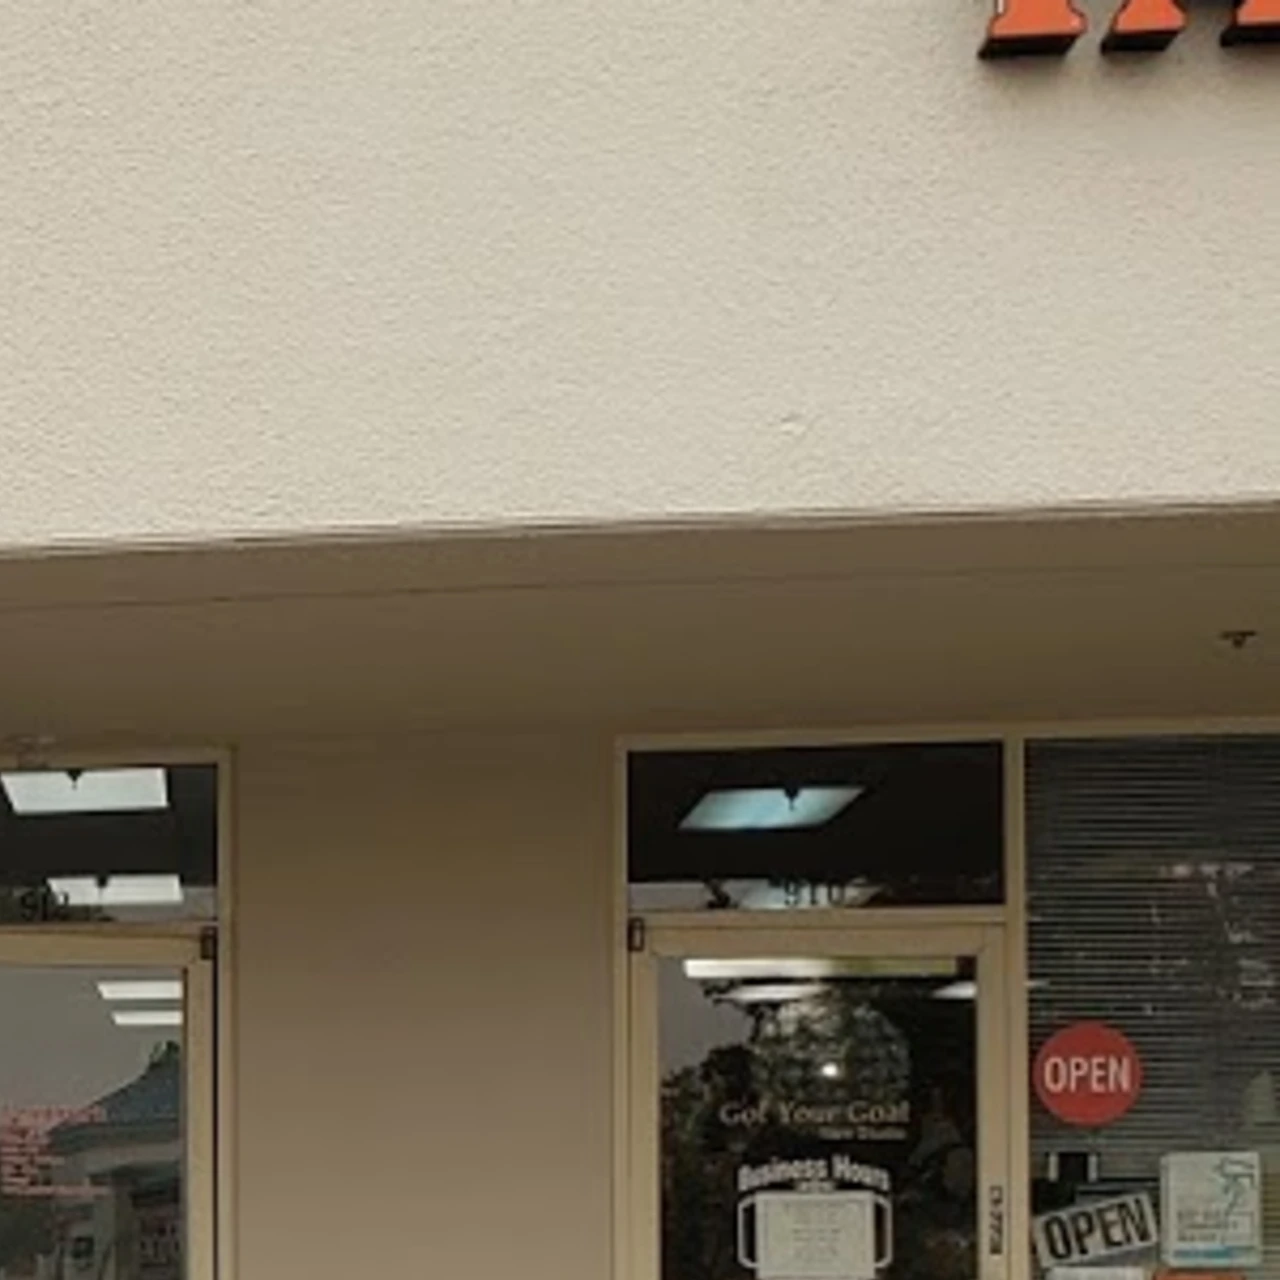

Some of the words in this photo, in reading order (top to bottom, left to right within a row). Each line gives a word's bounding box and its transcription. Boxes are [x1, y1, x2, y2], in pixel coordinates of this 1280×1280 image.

[1044, 1057, 1131, 1092] OPEN
[737, 1157, 829, 1191] Business
[831, 1153, 889, 1191] Hours
[1043, 1197, 1152, 1260] OPEN
